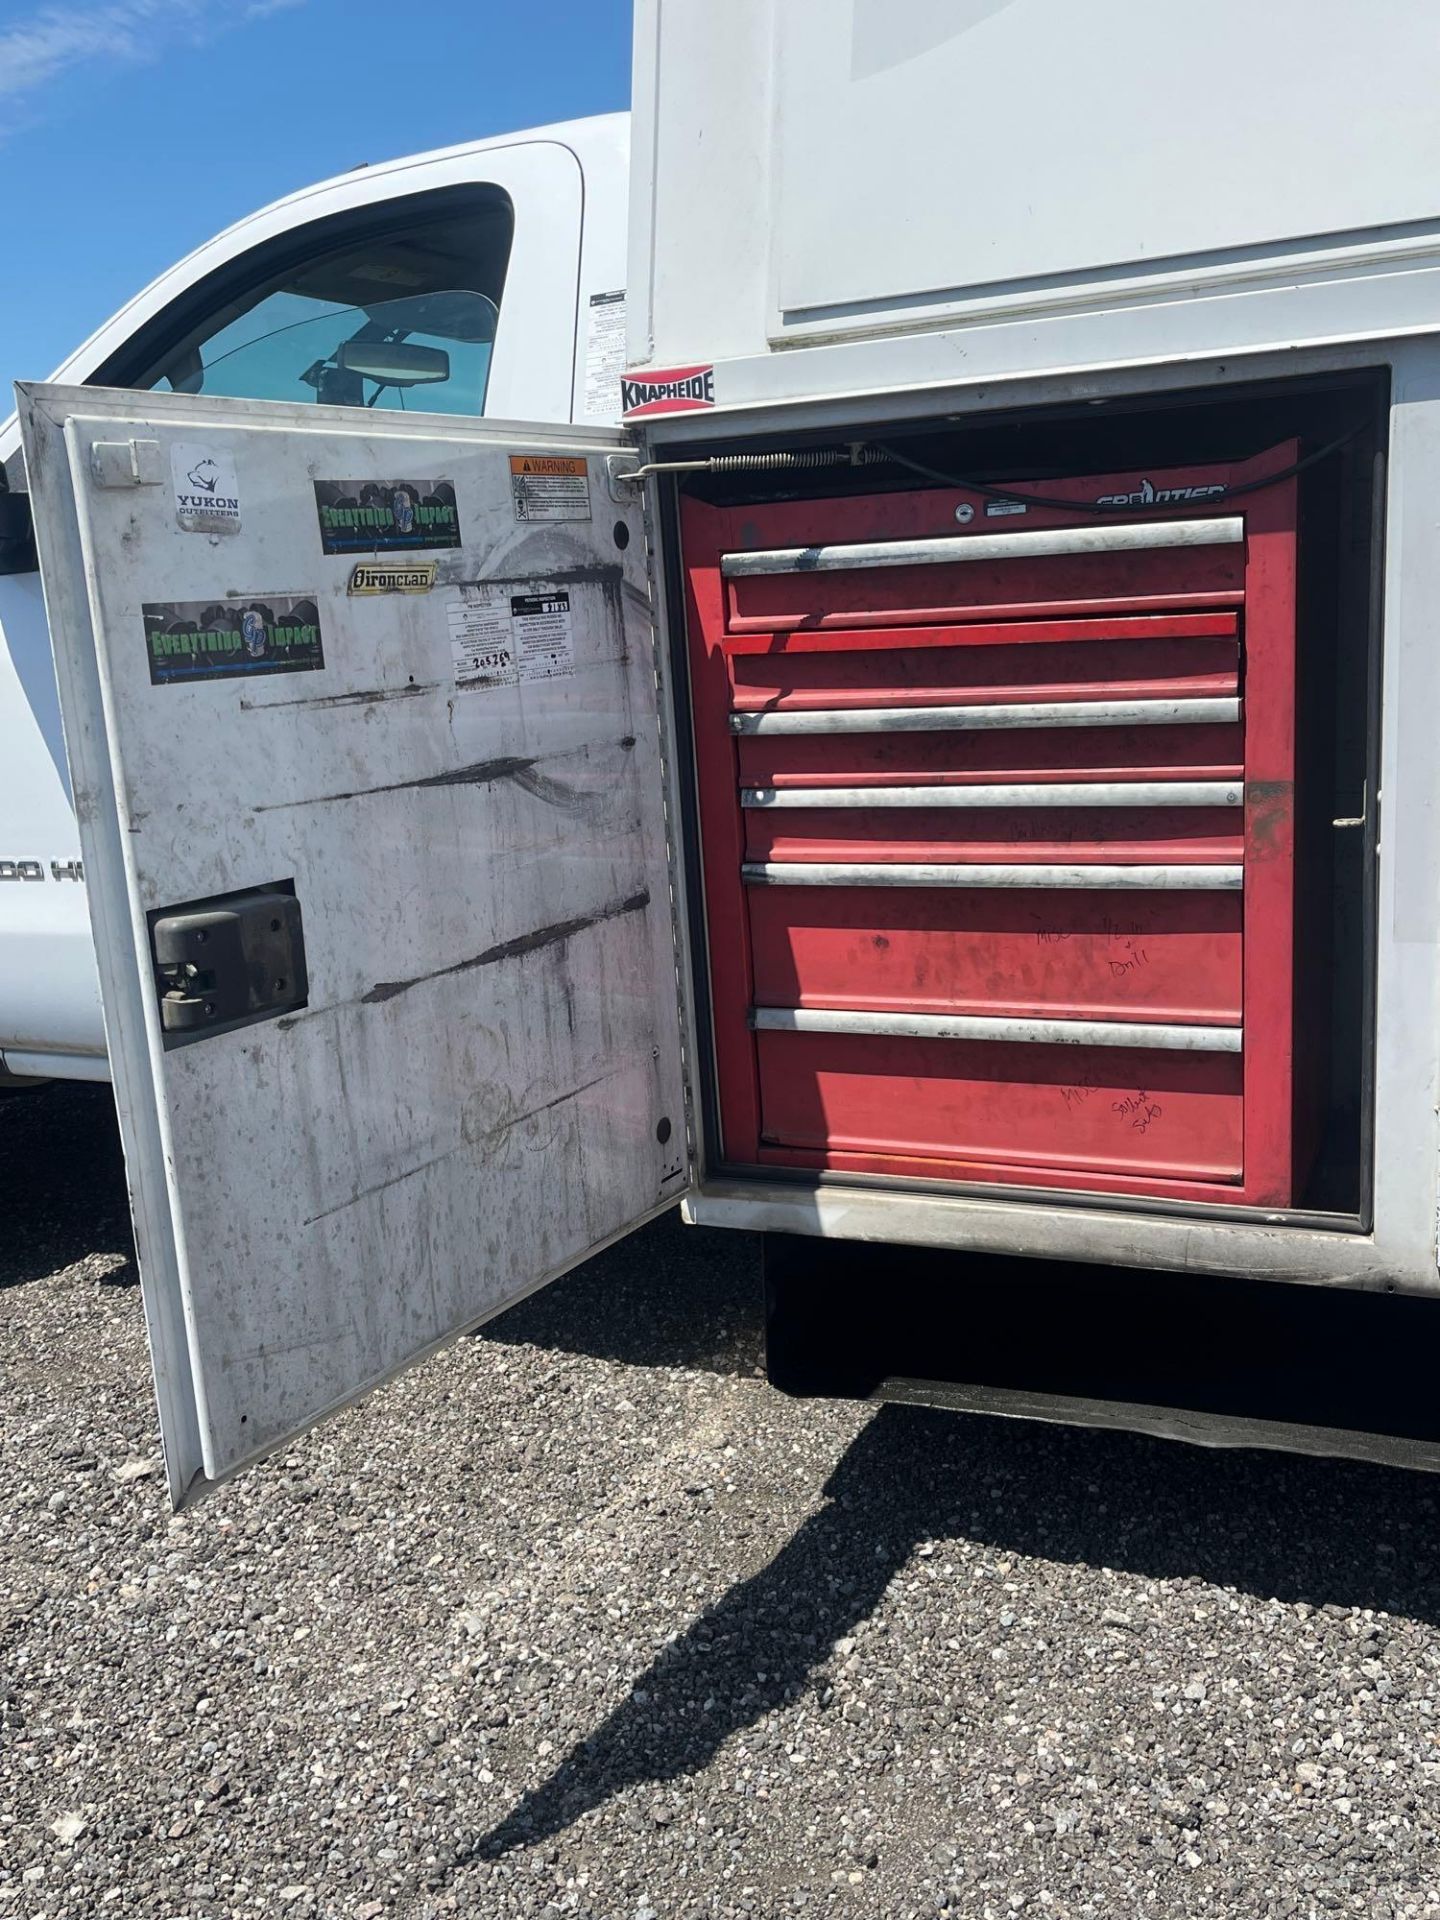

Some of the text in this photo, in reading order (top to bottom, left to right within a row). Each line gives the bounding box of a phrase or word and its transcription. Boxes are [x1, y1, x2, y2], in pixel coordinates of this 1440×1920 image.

[620, 370, 715, 412] KNAPHEIDE
[531, 460, 576, 474] WARNING
[177, 494, 239, 510] YUKON
[178, 507, 239, 518] OUTFITTERS
[321, 504, 394, 528] EVERYTHING
[414, 503, 456, 525] IMPACT
[151, 631, 243, 657] EVERYTHING
[267, 624, 318, 647] IMPACT
